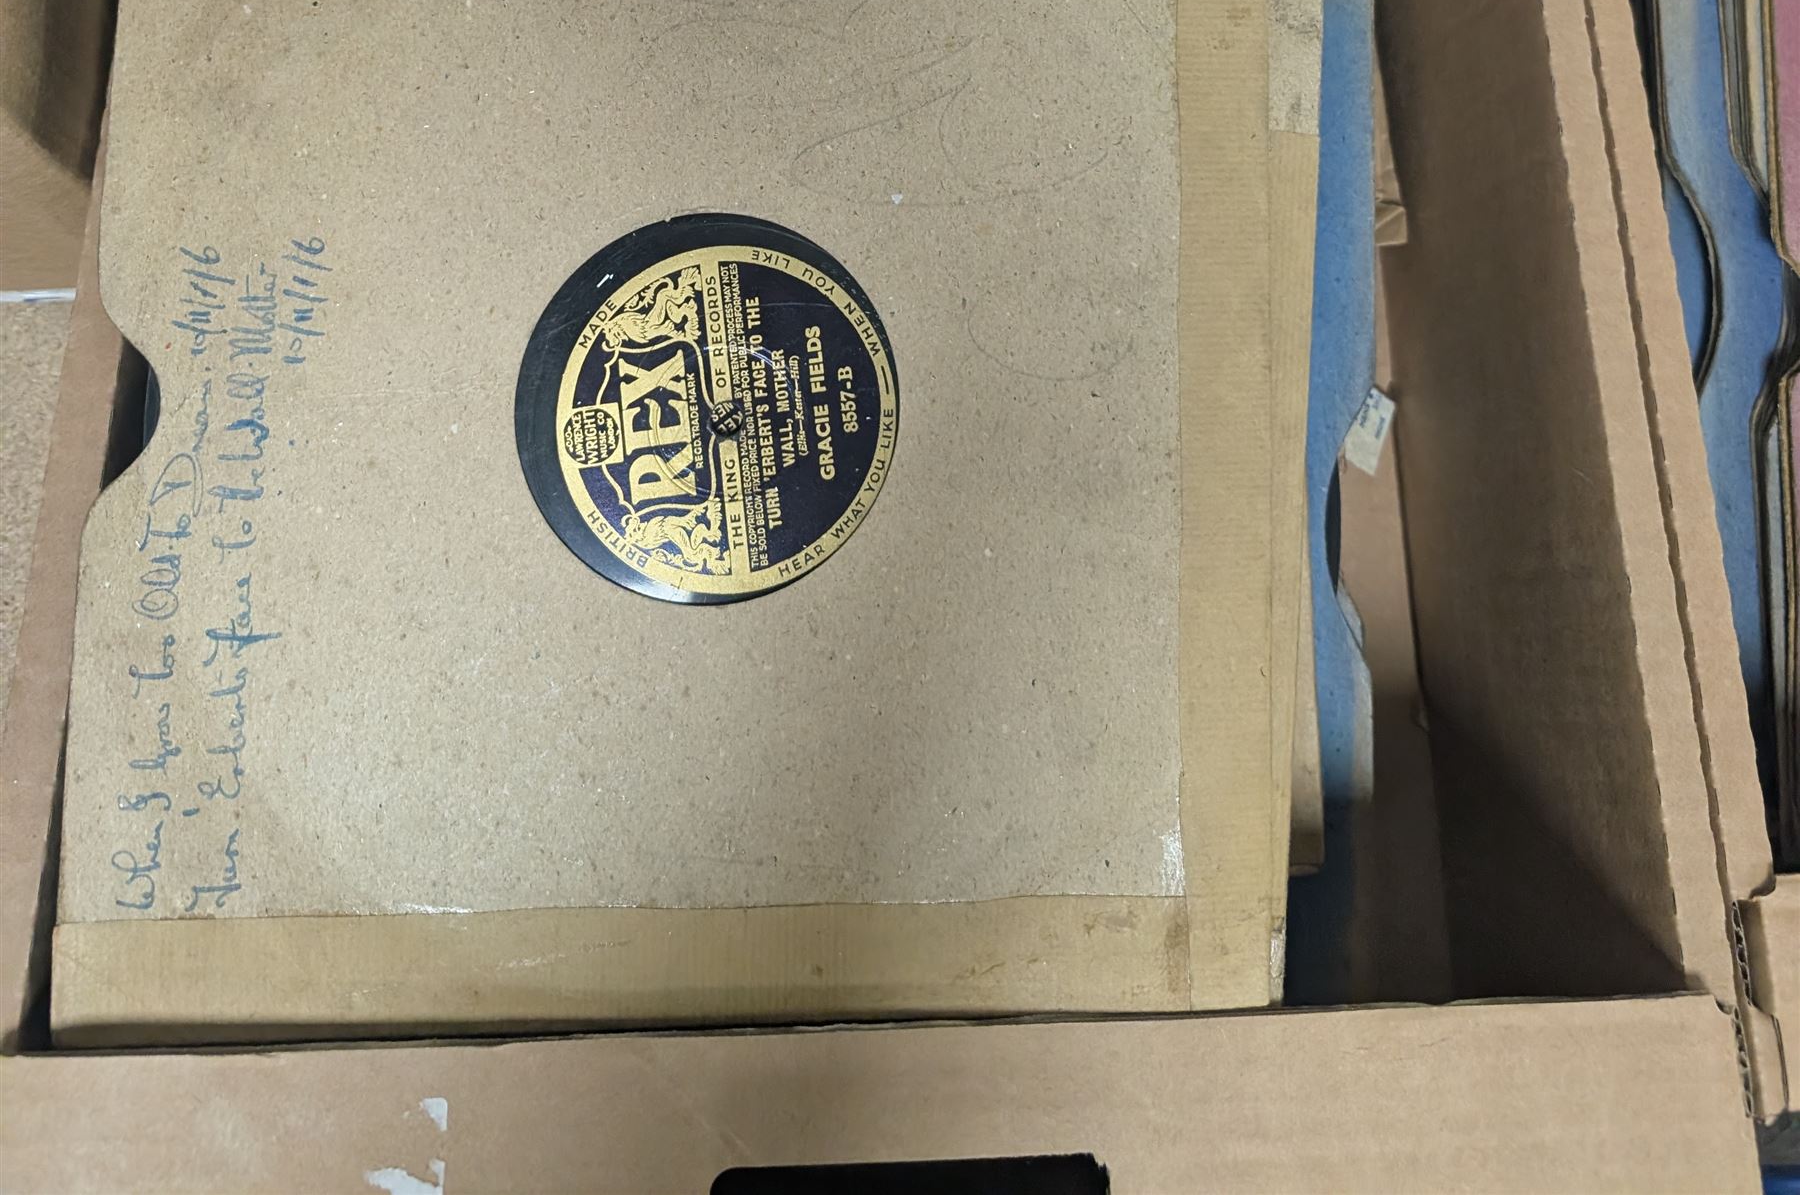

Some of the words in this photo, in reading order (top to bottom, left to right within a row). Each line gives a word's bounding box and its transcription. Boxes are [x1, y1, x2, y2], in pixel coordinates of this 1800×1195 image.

[720, 265, 729, 284] NOT
[751, 249, 790, 269] LIKE
[723, 284, 733, 303] MAY
[730, 262, 744, 334] PERFORMANCES
[801, 267, 837, 295] YOU
[578, 299, 617, 349] MADE
[705, 276, 724, 357] RECORDS
[725, 303, 736, 339] PROCESS
[746, 297, 760, 329] THE
[844, 301, 881, 356] WHEN
[737, 335, 748, 368] PUBLIC
[750, 334, 764, 353] TO
[805, 326, 827, 393] FIELDS
[714, 368, 727, 388] OF
[729, 341, 740, 385] PATENTED
[741, 369, 750, 388] FOR
[752, 360, 768, 398] FACE
[771, 349, 790, 412] MOTHER
[687, 373, 698, 404] MARK
[734, 387, 742, 399] BY
[743, 390, 754, 414] USED
[838, 366, 859, 433] 8557-B
[597, 412, 605, 425] CO
[606, 418, 616, 449] LONDON
[619, 349, 697, 504] REX
[746, 416, 755, 436] NOR
[881, 408, 893, 449] LIKE
[571, 414, 586, 462] LAWRENCE
[583, 410, 599, 465] WRIGHT
[599, 430, 608, 458] MUSIC
[740, 429, 748, 456] MADE
[748, 438, 758, 464] PRICE
[756, 404, 777, 481] 'ERBERT'S
[779, 418, 796, 467] WALL,
[813, 404, 835, 480] GRACIE
[724, 458, 740, 502] KING
[742, 457, 752, 494] RECORD
[752, 465, 761, 492] FIXED
[864, 458, 886, 493] YOU
[746, 495, 757, 545] COPYRIGHT
[755, 495, 765, 525] BELOW
[765, 486, 783, 529] TURN
[830, 495, 866, 539] WHAT
[587, 510, 649, 569] BRITISH
[729, 512, 744, 550] THE
[758, 527, 767, 551] SOLD
[751, 547, 760, 569] THIS
[761, 553, 769, 566] BE
[778, 543, 826, 578] HEAR
